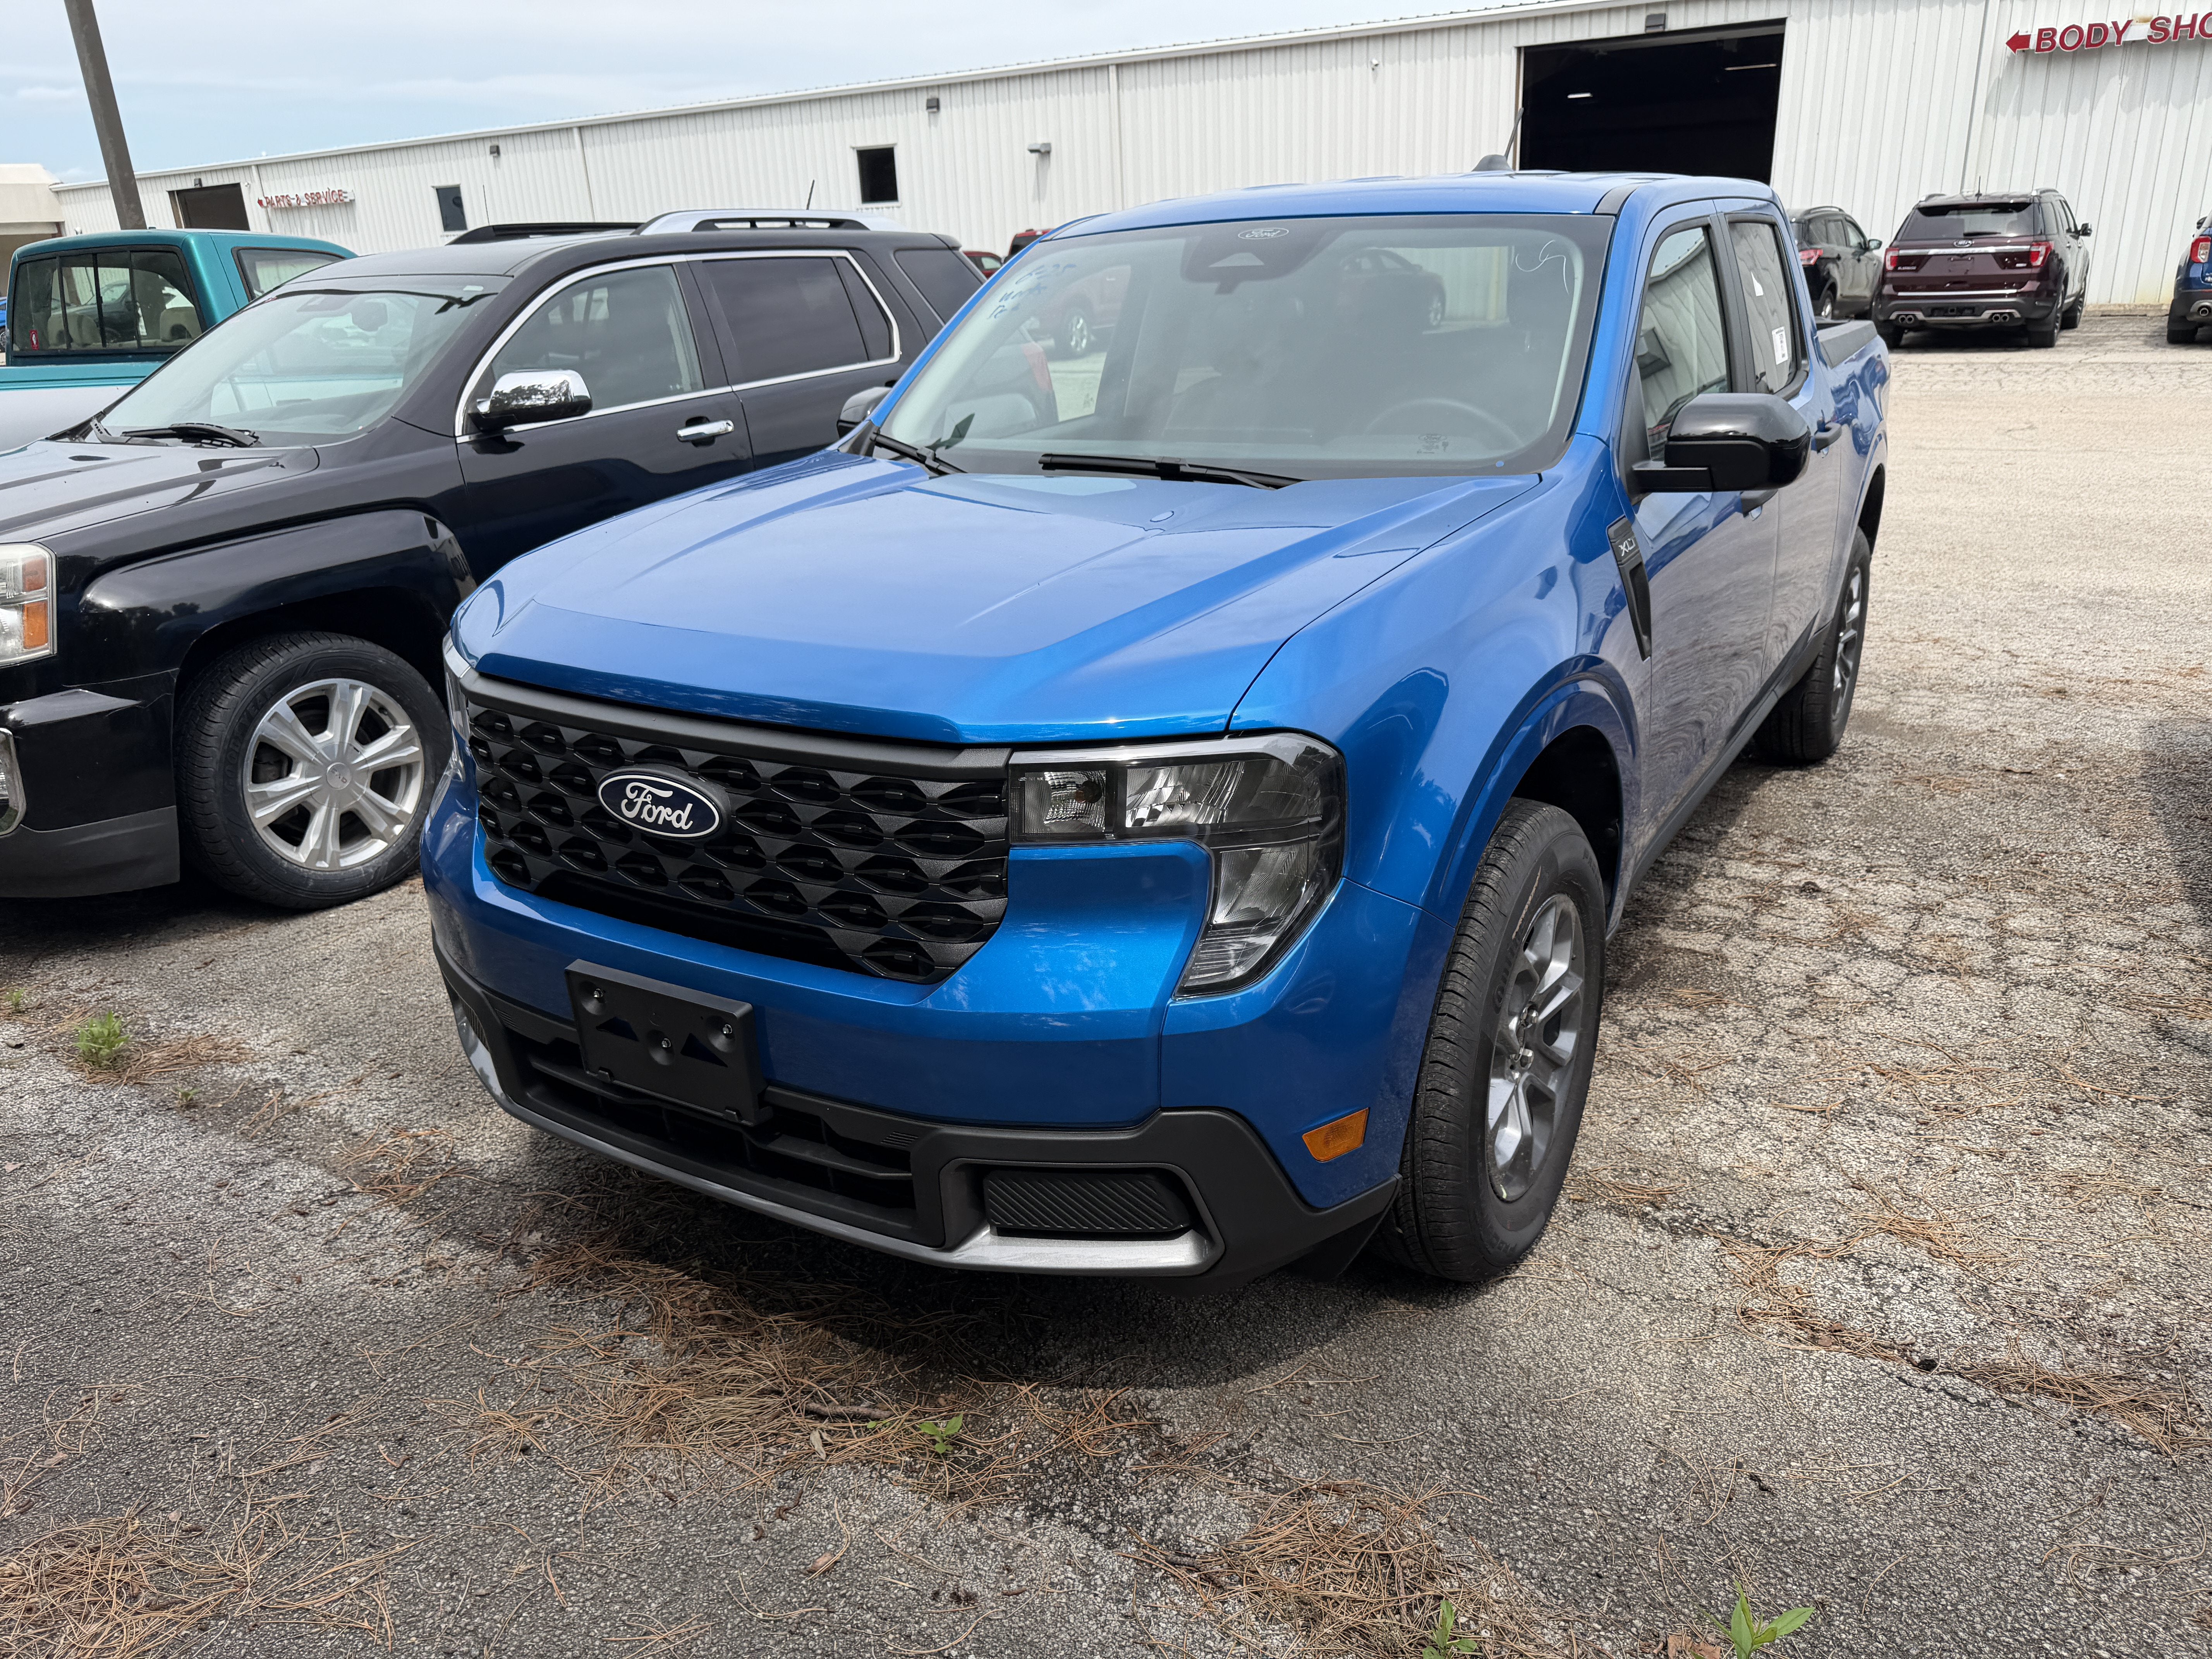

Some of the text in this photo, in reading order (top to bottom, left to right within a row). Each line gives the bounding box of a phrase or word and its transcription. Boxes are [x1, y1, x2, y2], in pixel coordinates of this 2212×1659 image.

[2035, 19, 2133, 53] BODY
[265, 194, 292, 208] PARTS
[304, 189, 344, 206] SERVICE
[1245, 229, 1281, 238] Ford
[621, 782, 693, 830] Ford
